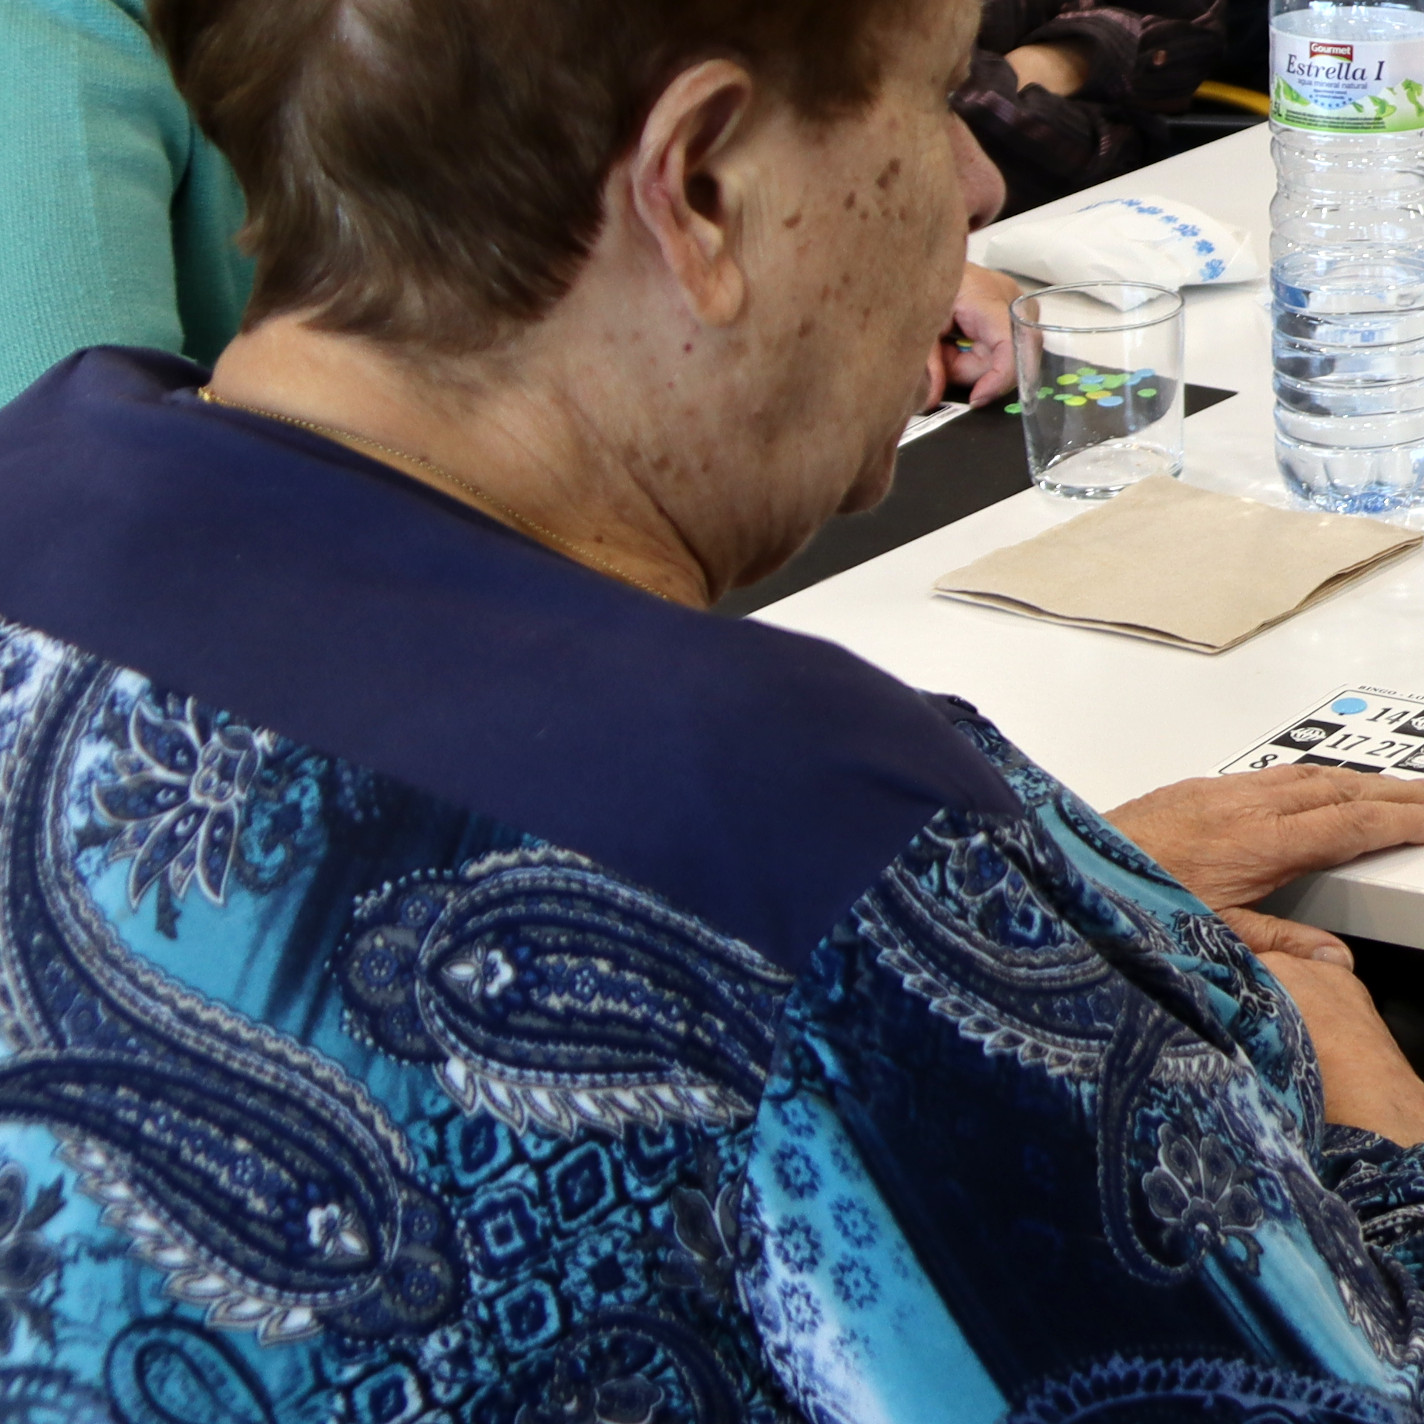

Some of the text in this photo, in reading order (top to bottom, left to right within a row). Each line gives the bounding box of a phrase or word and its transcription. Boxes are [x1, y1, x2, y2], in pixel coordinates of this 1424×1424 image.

[1310, 42, 1352, 55] Gourmet
[1286, 53, 1386, 81] Estrella I
[1314, 80, 1340, 89] mineral
[1341, 81, 1368, 90] natural
[1358, 685, 1397, 696] BINGO
[1366, 707, 1411, 725] 14
[1326, 733, 1371, 752] 17
[1366, 740, 1415, 759] 27
[1249, 753, 1279, 770] 8
